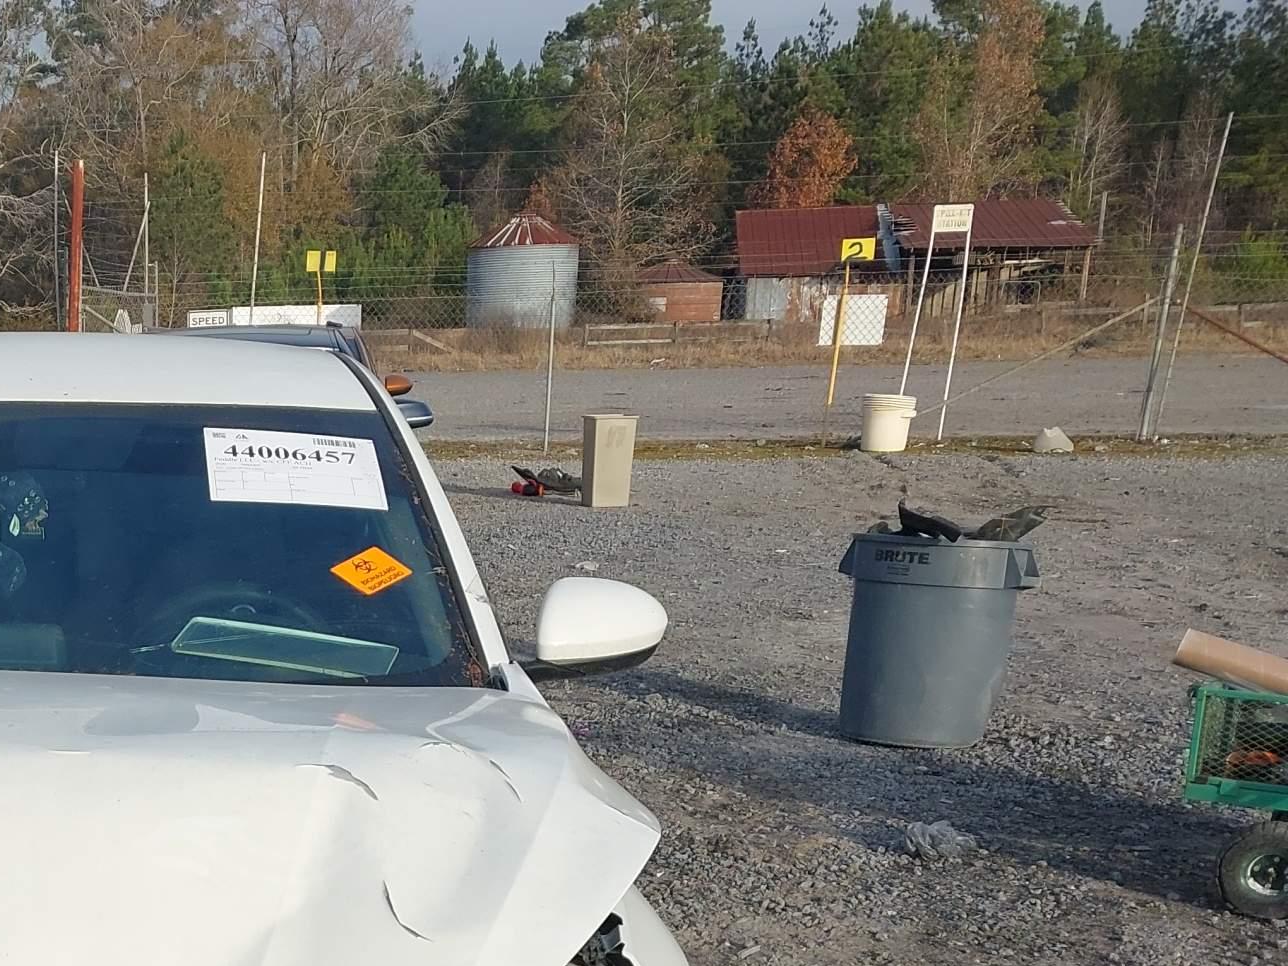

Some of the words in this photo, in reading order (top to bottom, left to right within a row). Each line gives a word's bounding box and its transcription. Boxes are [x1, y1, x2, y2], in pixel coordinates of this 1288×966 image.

[845, 242, 868, 260] 2
[192, 317, 225, 325] SPEED
[223, 444, 356, 465] 44006457
[875, 549, 931, 564] BRUTE
